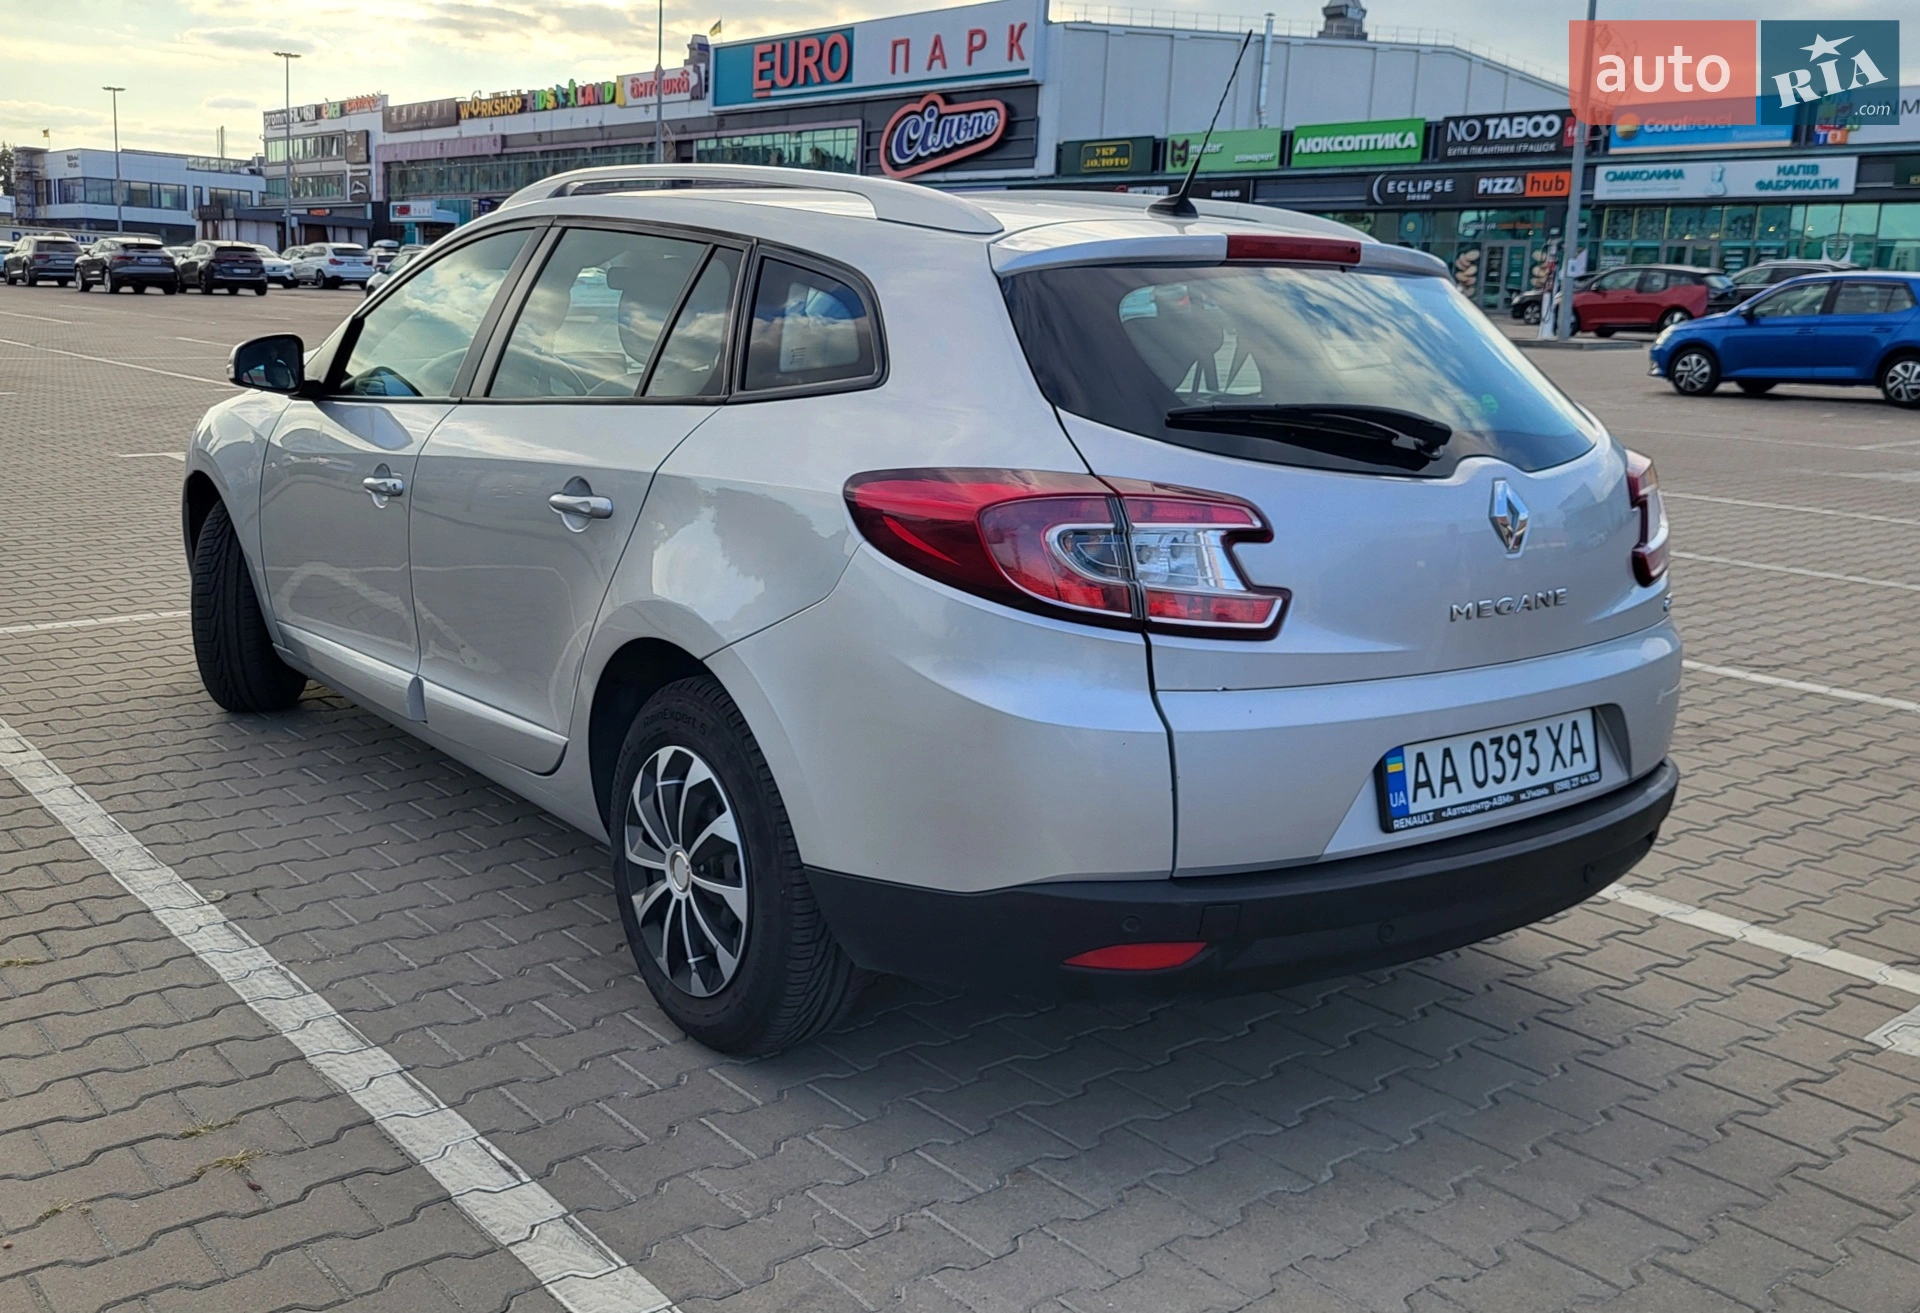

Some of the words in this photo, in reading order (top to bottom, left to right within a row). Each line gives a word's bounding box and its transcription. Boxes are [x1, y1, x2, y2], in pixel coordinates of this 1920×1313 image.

[753, 34, 849, 91] EURO
[890, 22, 1028, 75] ПАРК
[459, 95, 522, 119] WORKSHOP
[527, 87, 556, 112] KIDS
[577, 81, 615, 106] LAND
[891, 104, 1000, 164] Сільпо
[1446, 119, 1482, 142] NO
[1484, 114, 1561, 140] TABOO
[1096, 147, 1118, 157] УКР
[1190, 143, 1222, 154] mater
[1294, 131, 1418, 154] ЛЮКСОПТИКА
[1387, 178, 1455, 195] ECLIPSE
[1477, 176, 1525, 195] PIZZA
[1530, 174, 1565, 192] hub
[1755, 178, 1840, 191] ФАБРИКАТИ
[1449, 587, 1568, 622] MEGANE
[1412, 747, 1463, 804] AA
[1469, 728, 1541, 789] 0393
[1545, 719, 1588, 773] XA
[1389, 792, 1407, 808] UA
[1393, 811, 1435, 830] RENAULT
